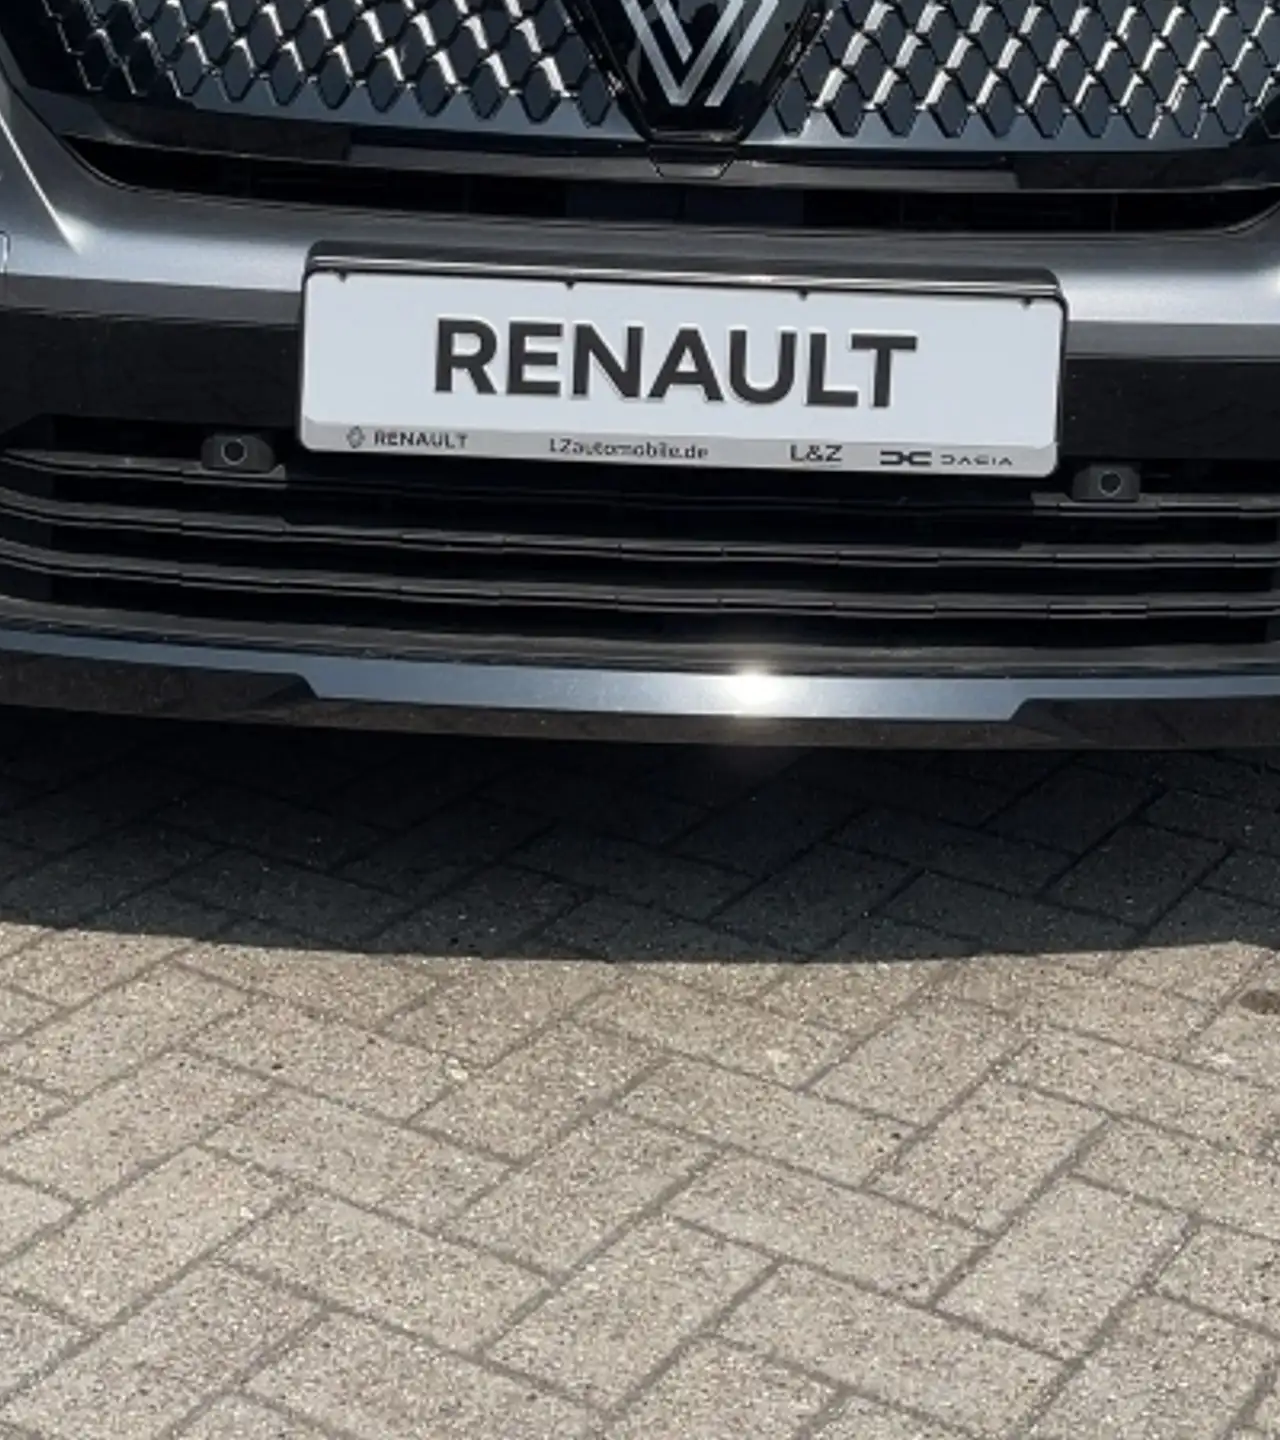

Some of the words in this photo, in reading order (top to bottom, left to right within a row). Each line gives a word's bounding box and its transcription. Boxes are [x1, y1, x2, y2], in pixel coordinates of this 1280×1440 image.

[434, 317, 919, 409] RENAULT
[373, 429, 469, 450] RENAULT
[789, 444, 844, 462] L&Z
[940, 453, 1013, 467] DACIA
